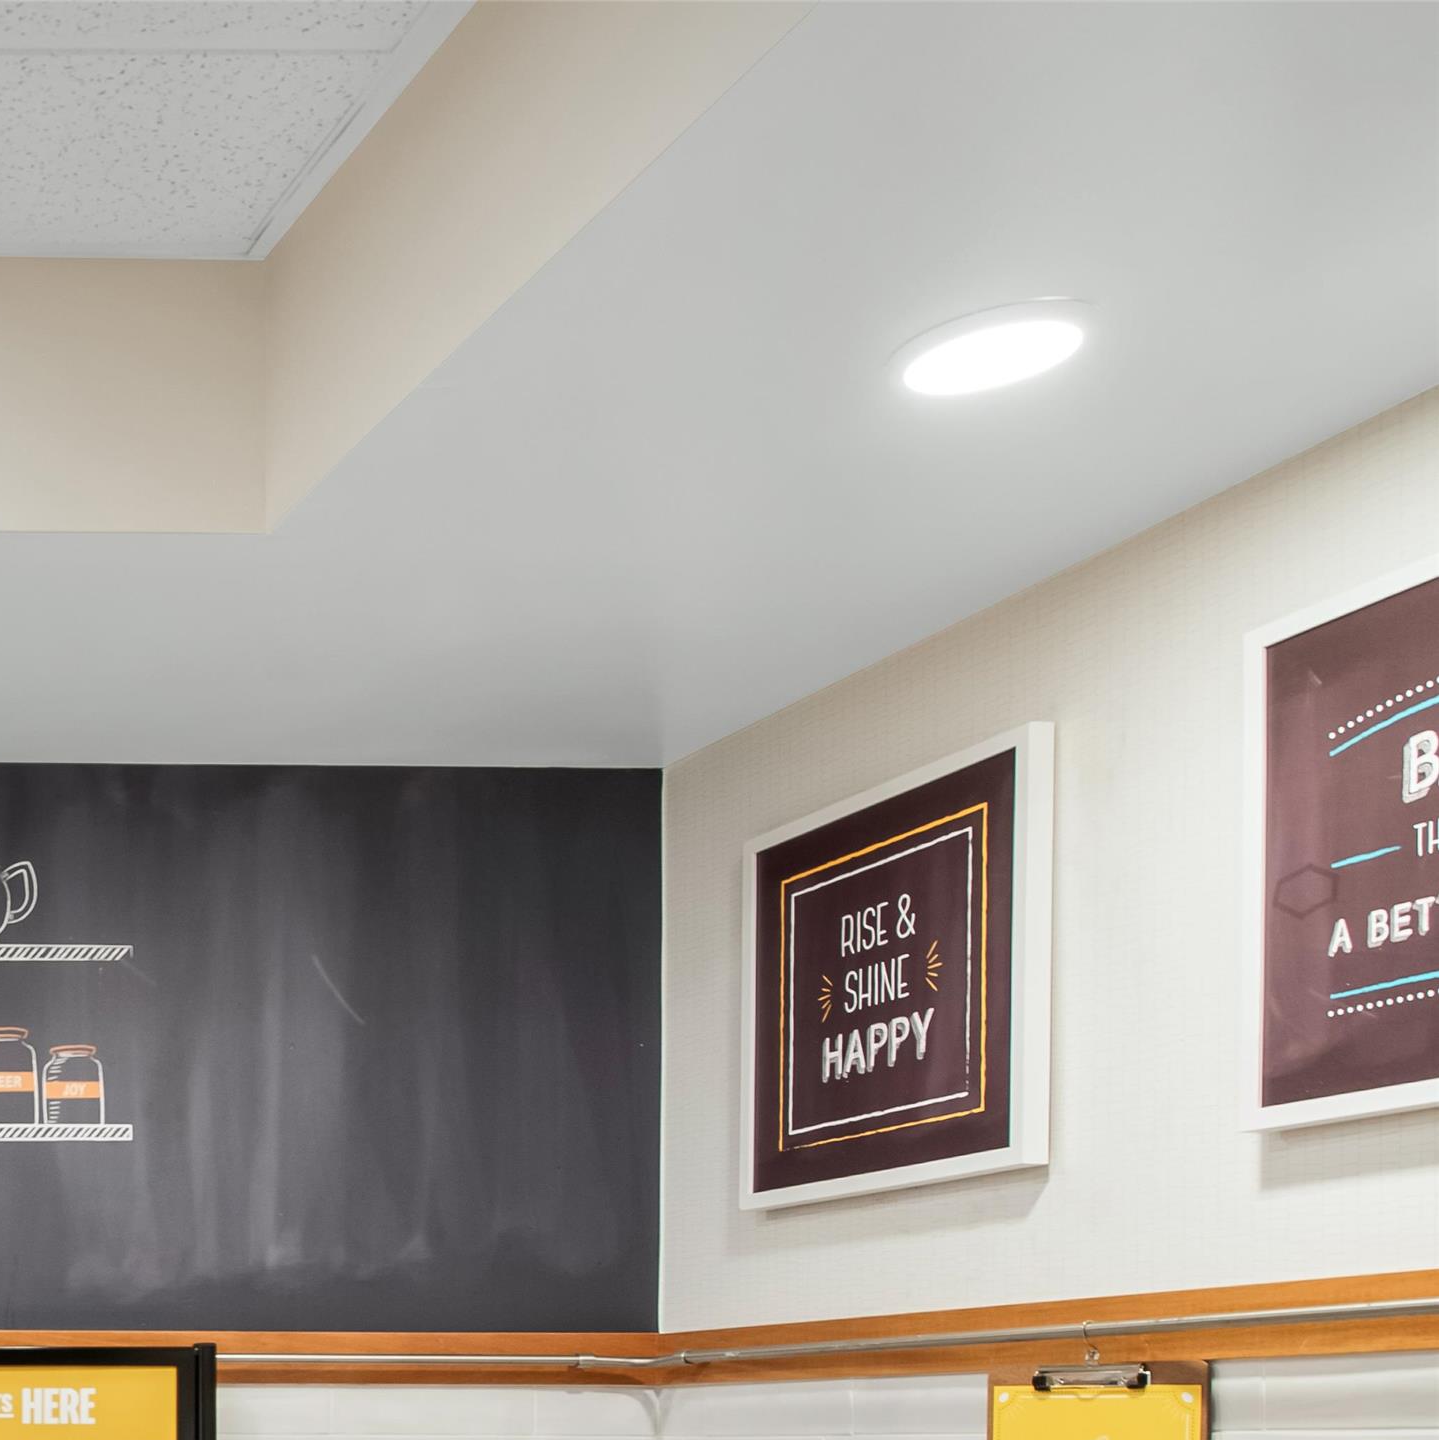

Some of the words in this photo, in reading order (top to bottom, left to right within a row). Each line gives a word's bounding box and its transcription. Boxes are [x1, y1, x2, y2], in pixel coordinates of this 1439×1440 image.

[1402, 730, 1439, 804] B
[841, 901, 889, 957] RISE
[895, 893, 916, 939] &
[1327, 918, 1353, 957] A
[1366, 894, 1439, 948] BET
[844, 953, 910, 1013] SHINE
[822, 1007, 934, 1083] HAPPY
[63, 1083, 87, 1095] JOY
[22, 1387, 96, 1425] HERE
